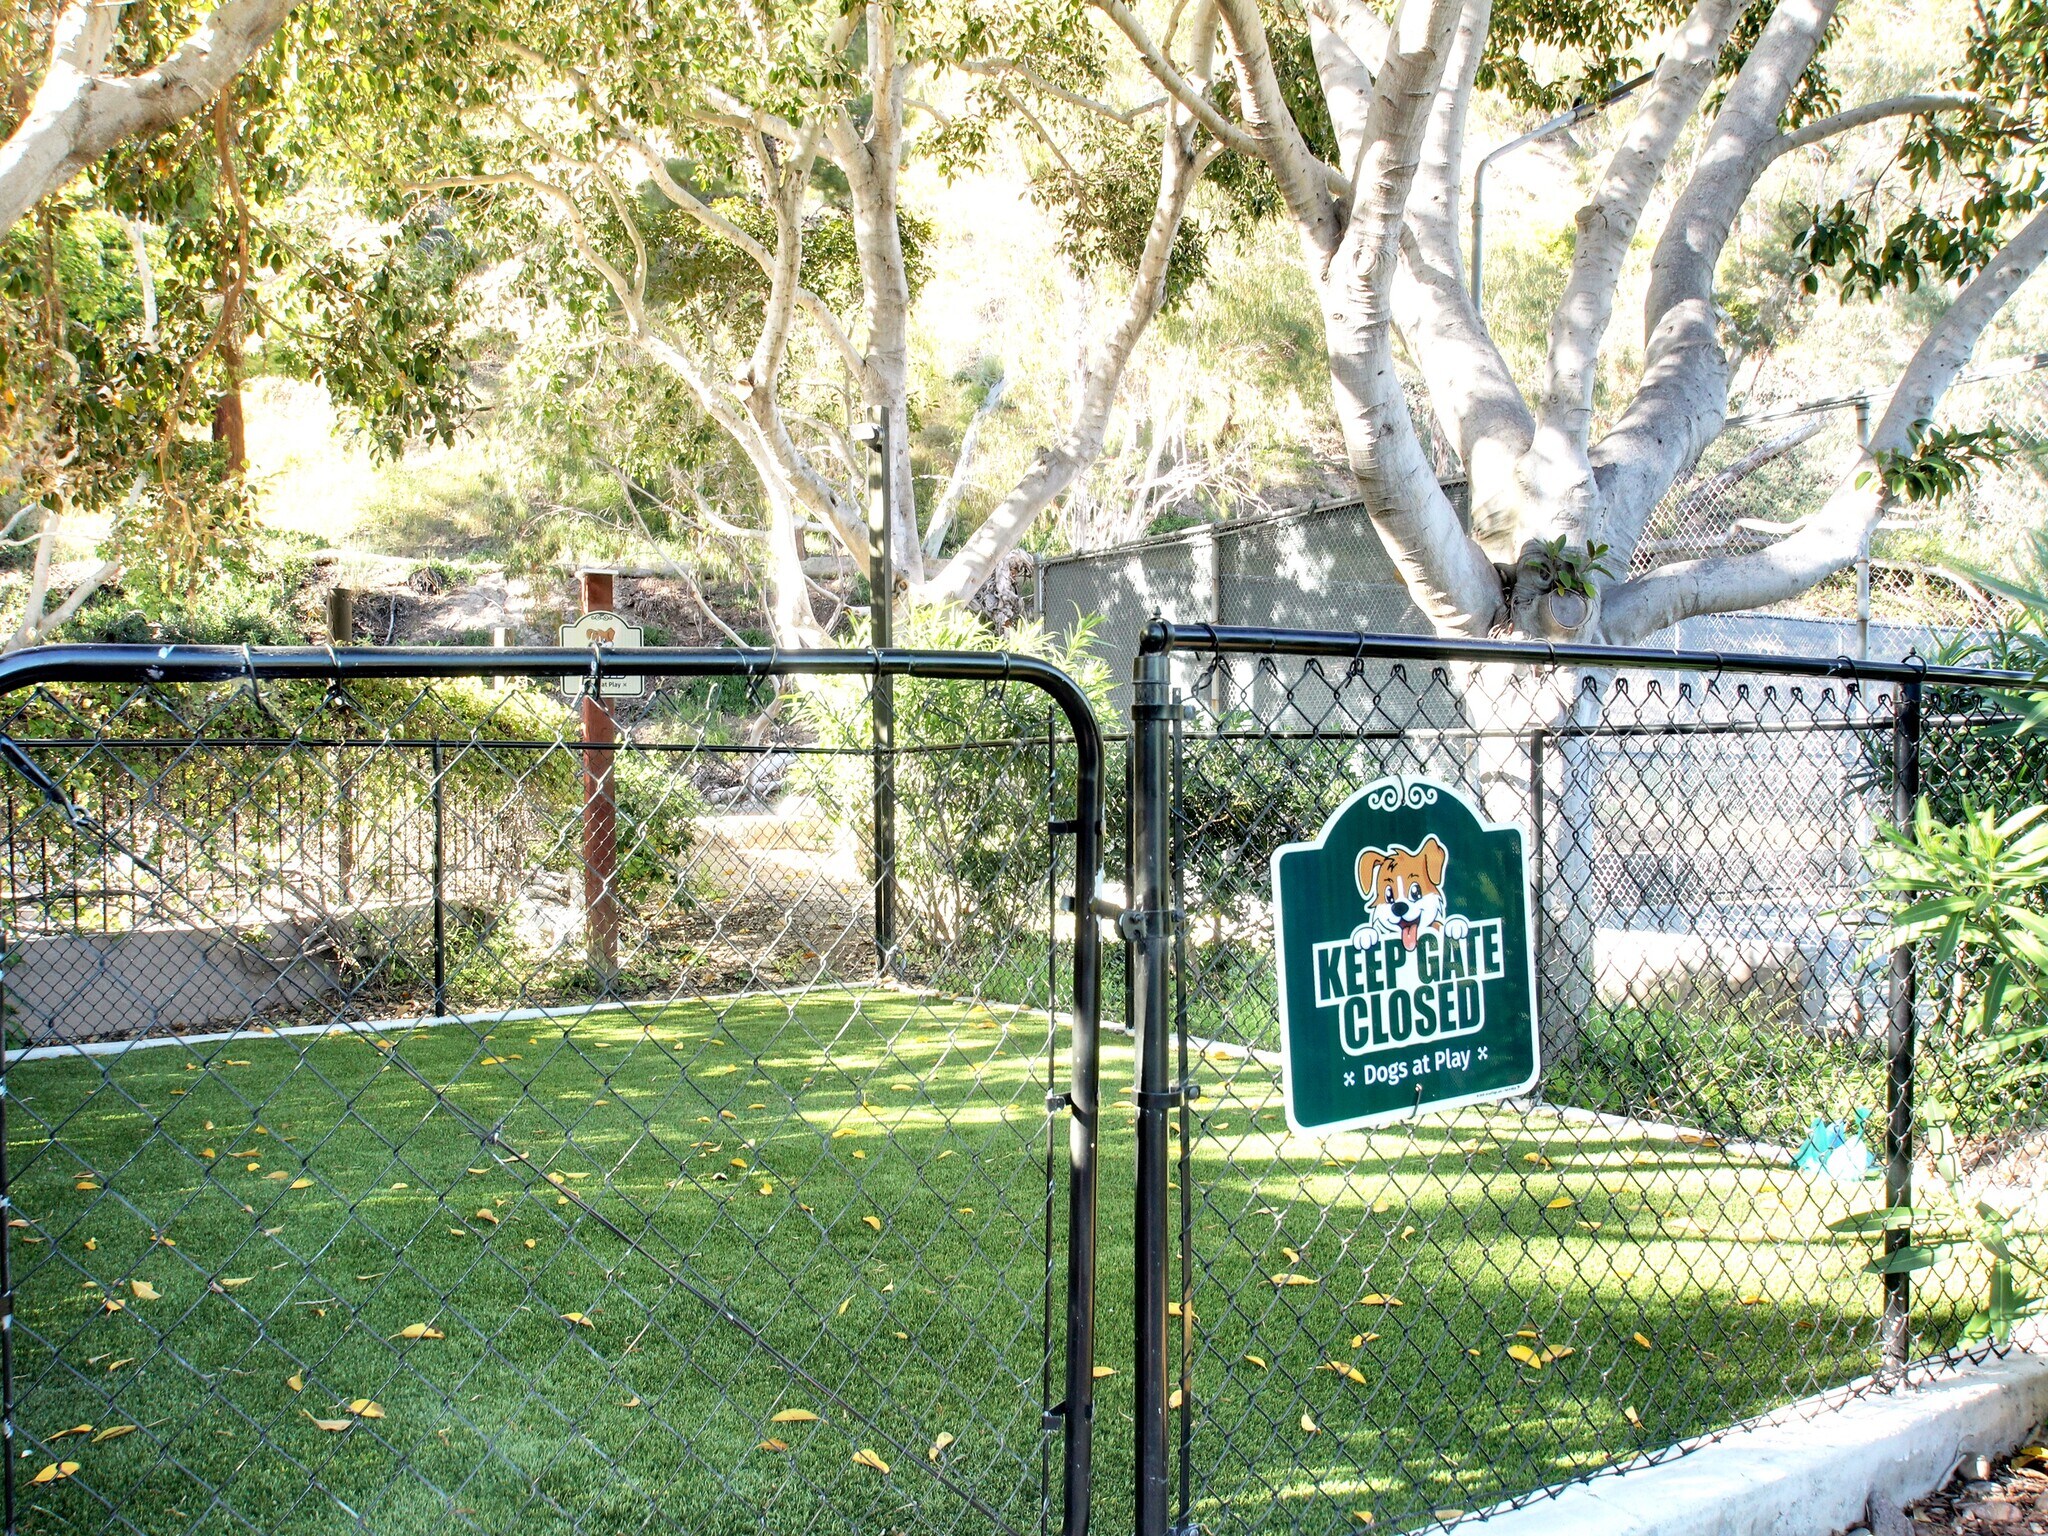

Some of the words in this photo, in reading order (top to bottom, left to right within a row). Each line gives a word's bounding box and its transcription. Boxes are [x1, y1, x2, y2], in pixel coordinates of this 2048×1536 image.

[1318, 938, 1406, 1000] KEEP
[1416, 924, 1501, 985] GATE
[1344, 979, 1481, 1049] CLOSED
[1363, 1061, 1408, 1086] Dogs
[1412, 1054, 1431, 1076] at
[1434, 1049, 1471, 1071] Play
